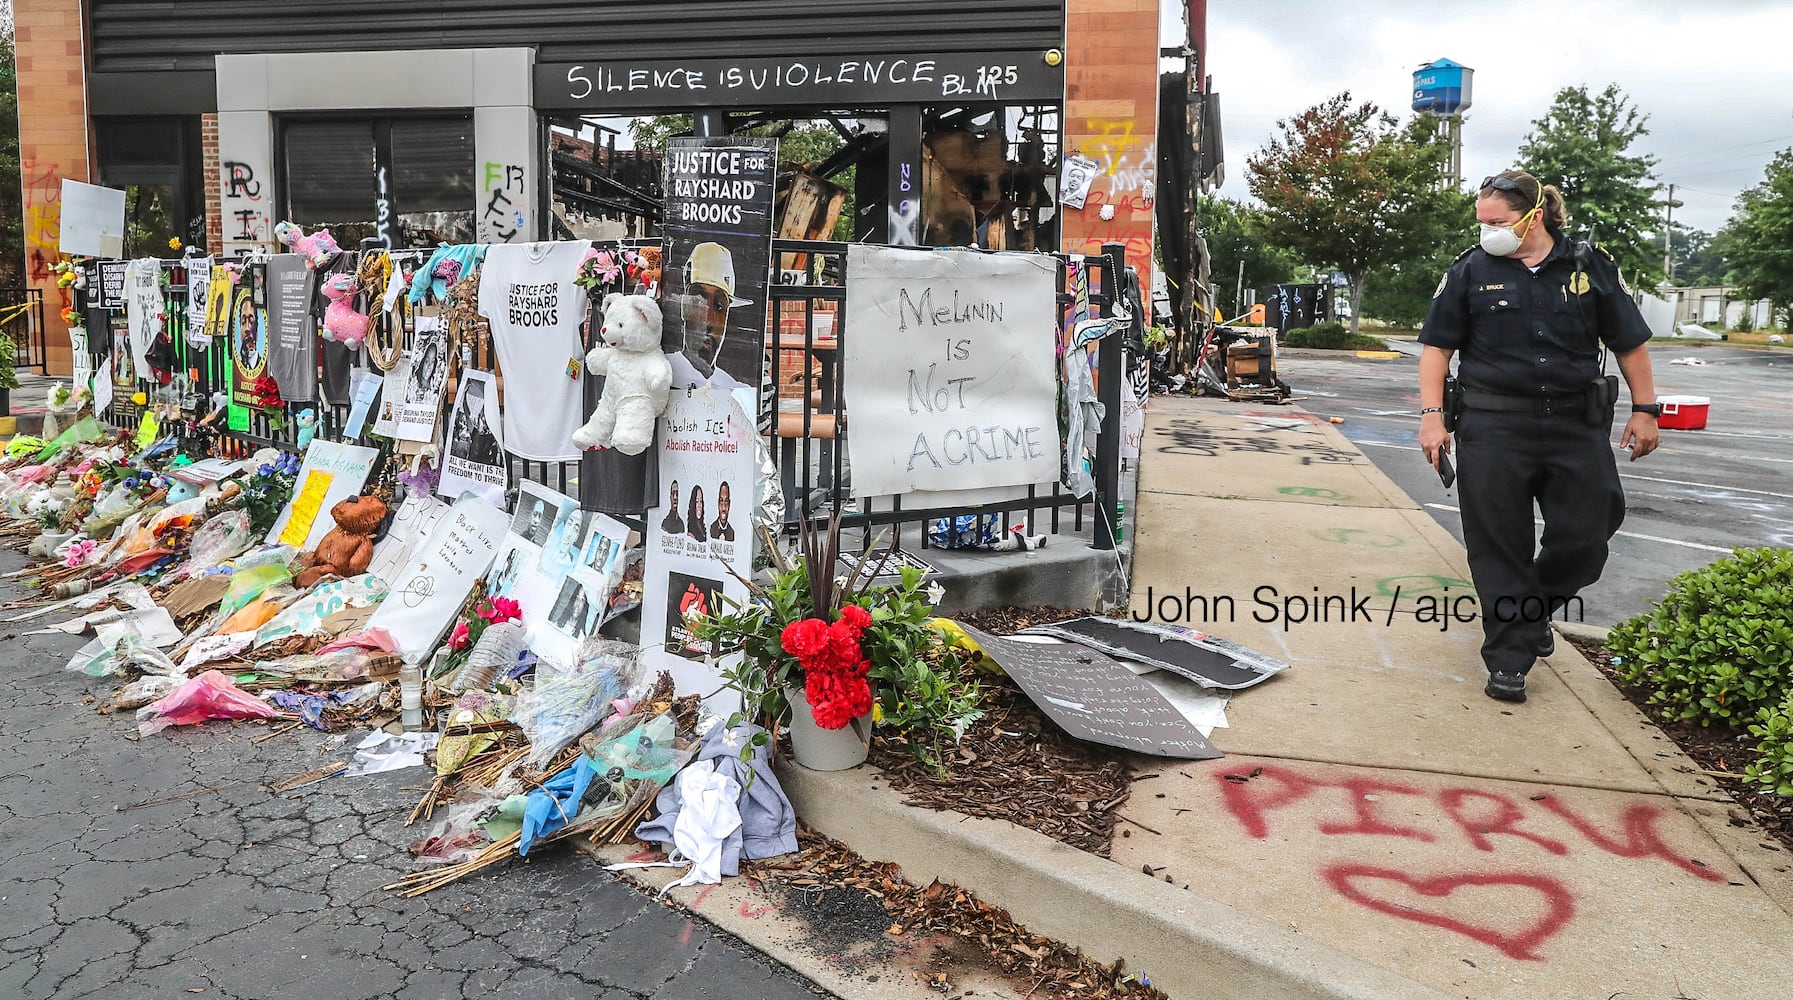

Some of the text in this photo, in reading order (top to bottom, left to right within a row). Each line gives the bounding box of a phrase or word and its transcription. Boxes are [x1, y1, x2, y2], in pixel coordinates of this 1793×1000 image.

[567, 66, 706, 99] SILENCE
[719, 68, 743, 88] IS
[976, 65, 1018, 86] 125
[942, 74, 998, 101] BLM
[672, 151, 765, 175] JUSTICE FOR
[674, 178, 756, 200] RAYSHARD
[682, 202, 742, 225] BROOKS
[509, 282, 558, 296] JUSTICE FOR
[509, 295, 558, 310] RAYSHARD
[509, 309, 558, 327] BROOKS
[946, 338, 971, 361] IS
[667, 414, 731, 438] Abolish ICE!
[666, 440, 738, 453] Abolish Racist Police!
[907, 425, 1044, 473] A CRIME
[448, 455, 504, 477] ALL WE WANT IS THE
[448, 465, 504, 487] FREEDOM TO THRIVE
[1214, 765, 1727, 883] PIRU
